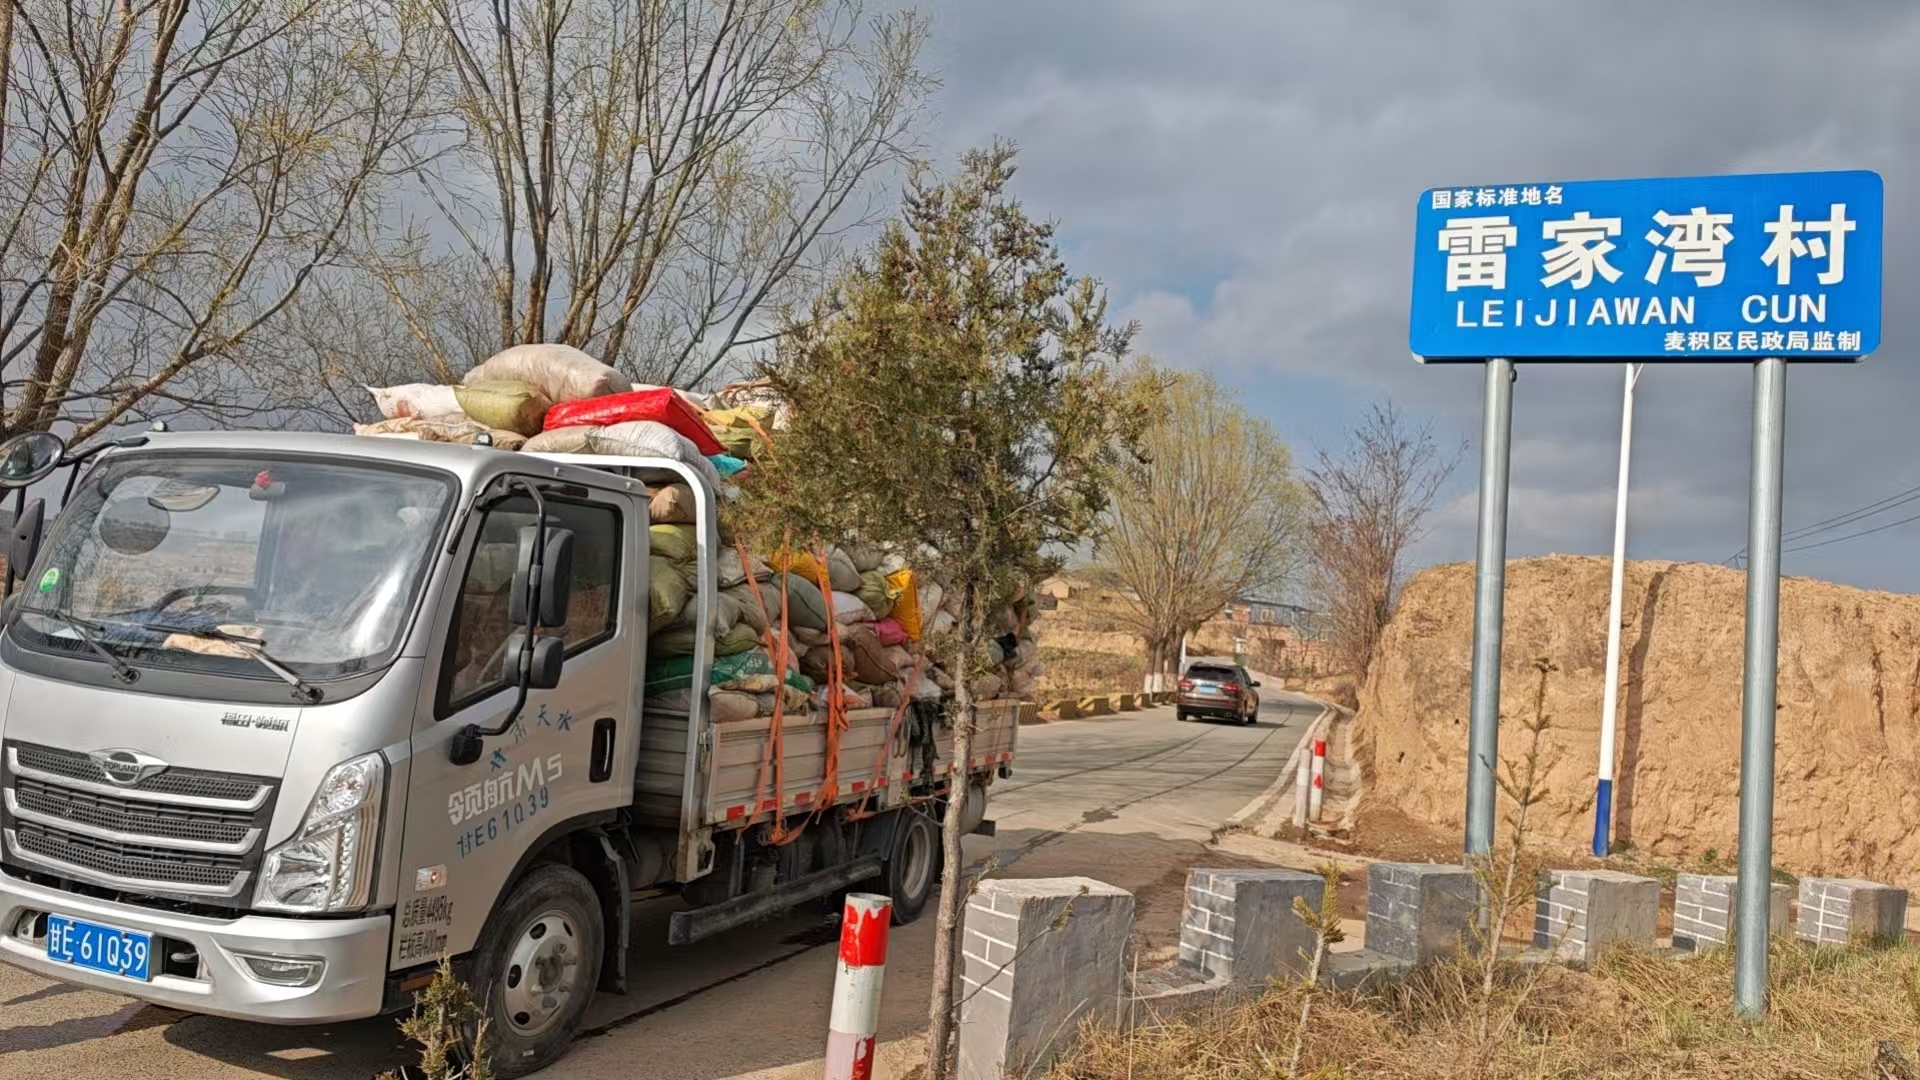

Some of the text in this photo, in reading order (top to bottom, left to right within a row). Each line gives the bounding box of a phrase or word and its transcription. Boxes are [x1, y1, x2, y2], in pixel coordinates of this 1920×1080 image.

[1431, 186, 1564, 209] 国家标准地名
[1437, 203, 1857, 292] 雷家湾村
[1456, 294, 1827, 328] LEIJIAWAN CUN
[1663, 330, 1862, 352] 麦积区民政局监制
[103, 760, 140, 774] FORLAND
